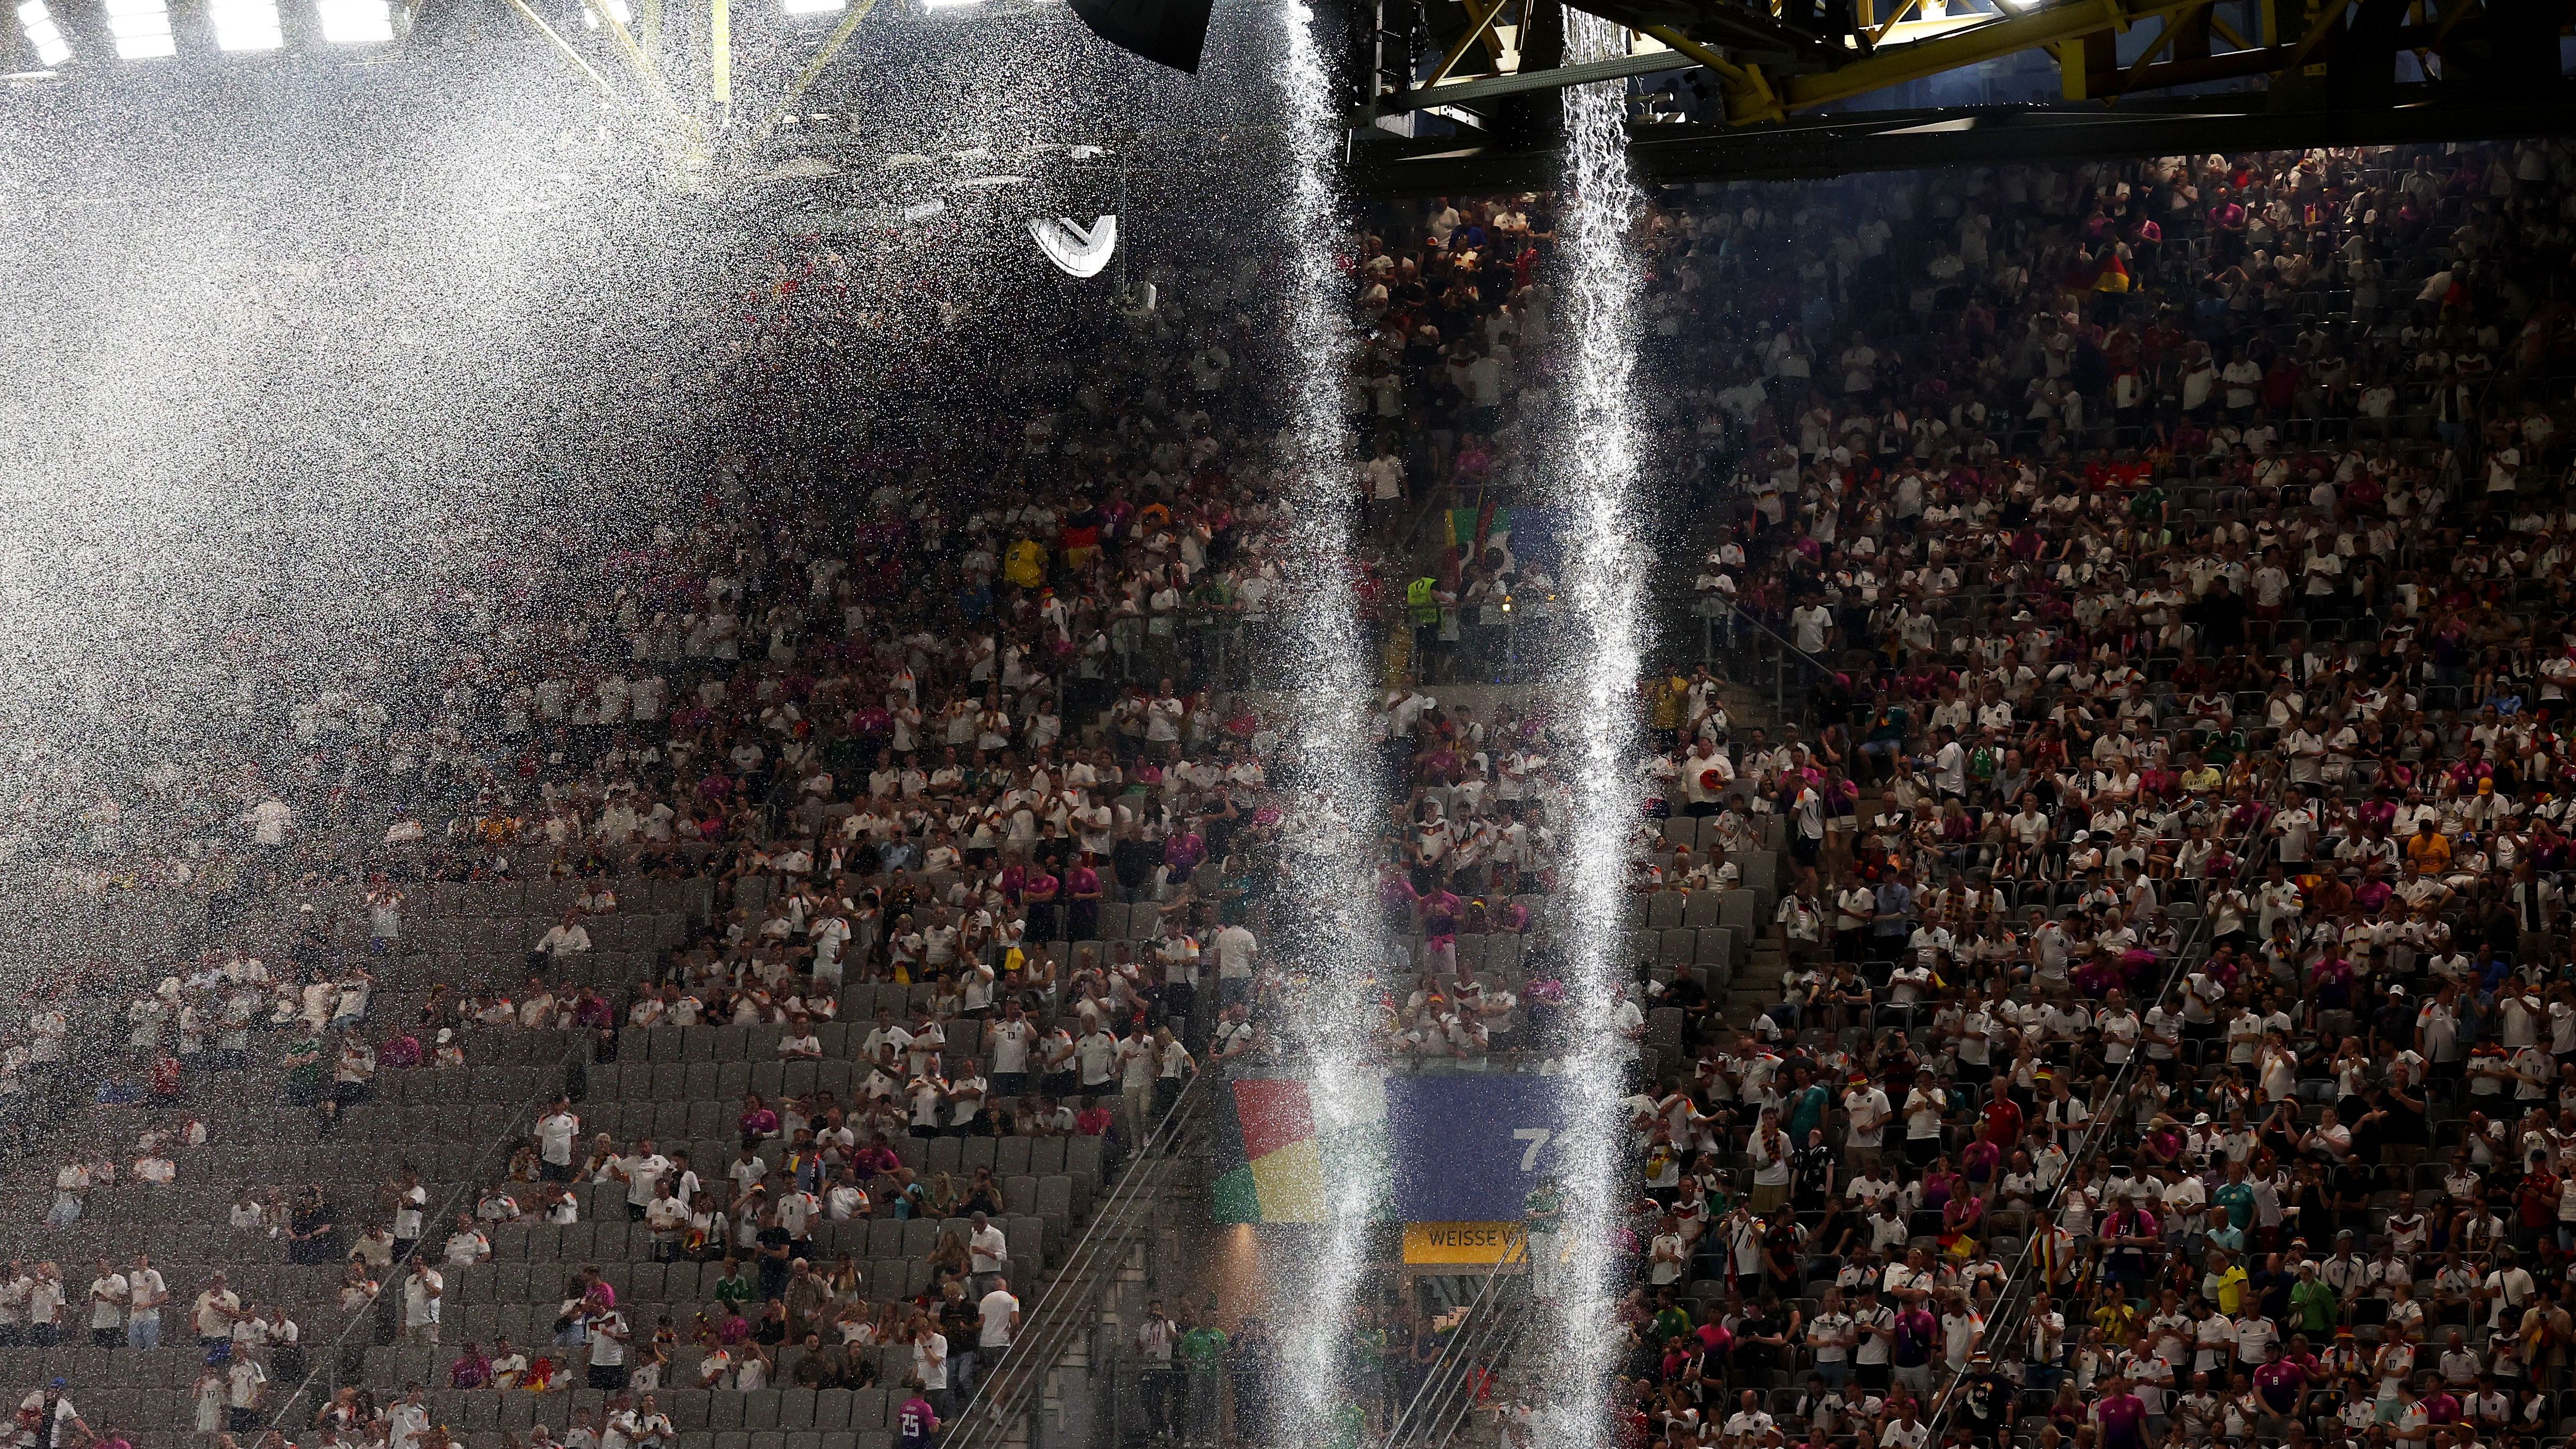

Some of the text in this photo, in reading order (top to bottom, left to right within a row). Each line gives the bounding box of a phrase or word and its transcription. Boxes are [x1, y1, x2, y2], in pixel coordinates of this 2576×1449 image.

[2468, 776, 2472, 784] 8
[2533, 1065, 2541, 1074] 17
[1429, 1230, 1496, 1246] WEISSE
[2389, 1359, 2396, 1369] 17
[2273, 1377, 2278, 1385] 8
[902, 1413, 919, 1437] 25
[2355, 1417, 2360, 1426] 7
